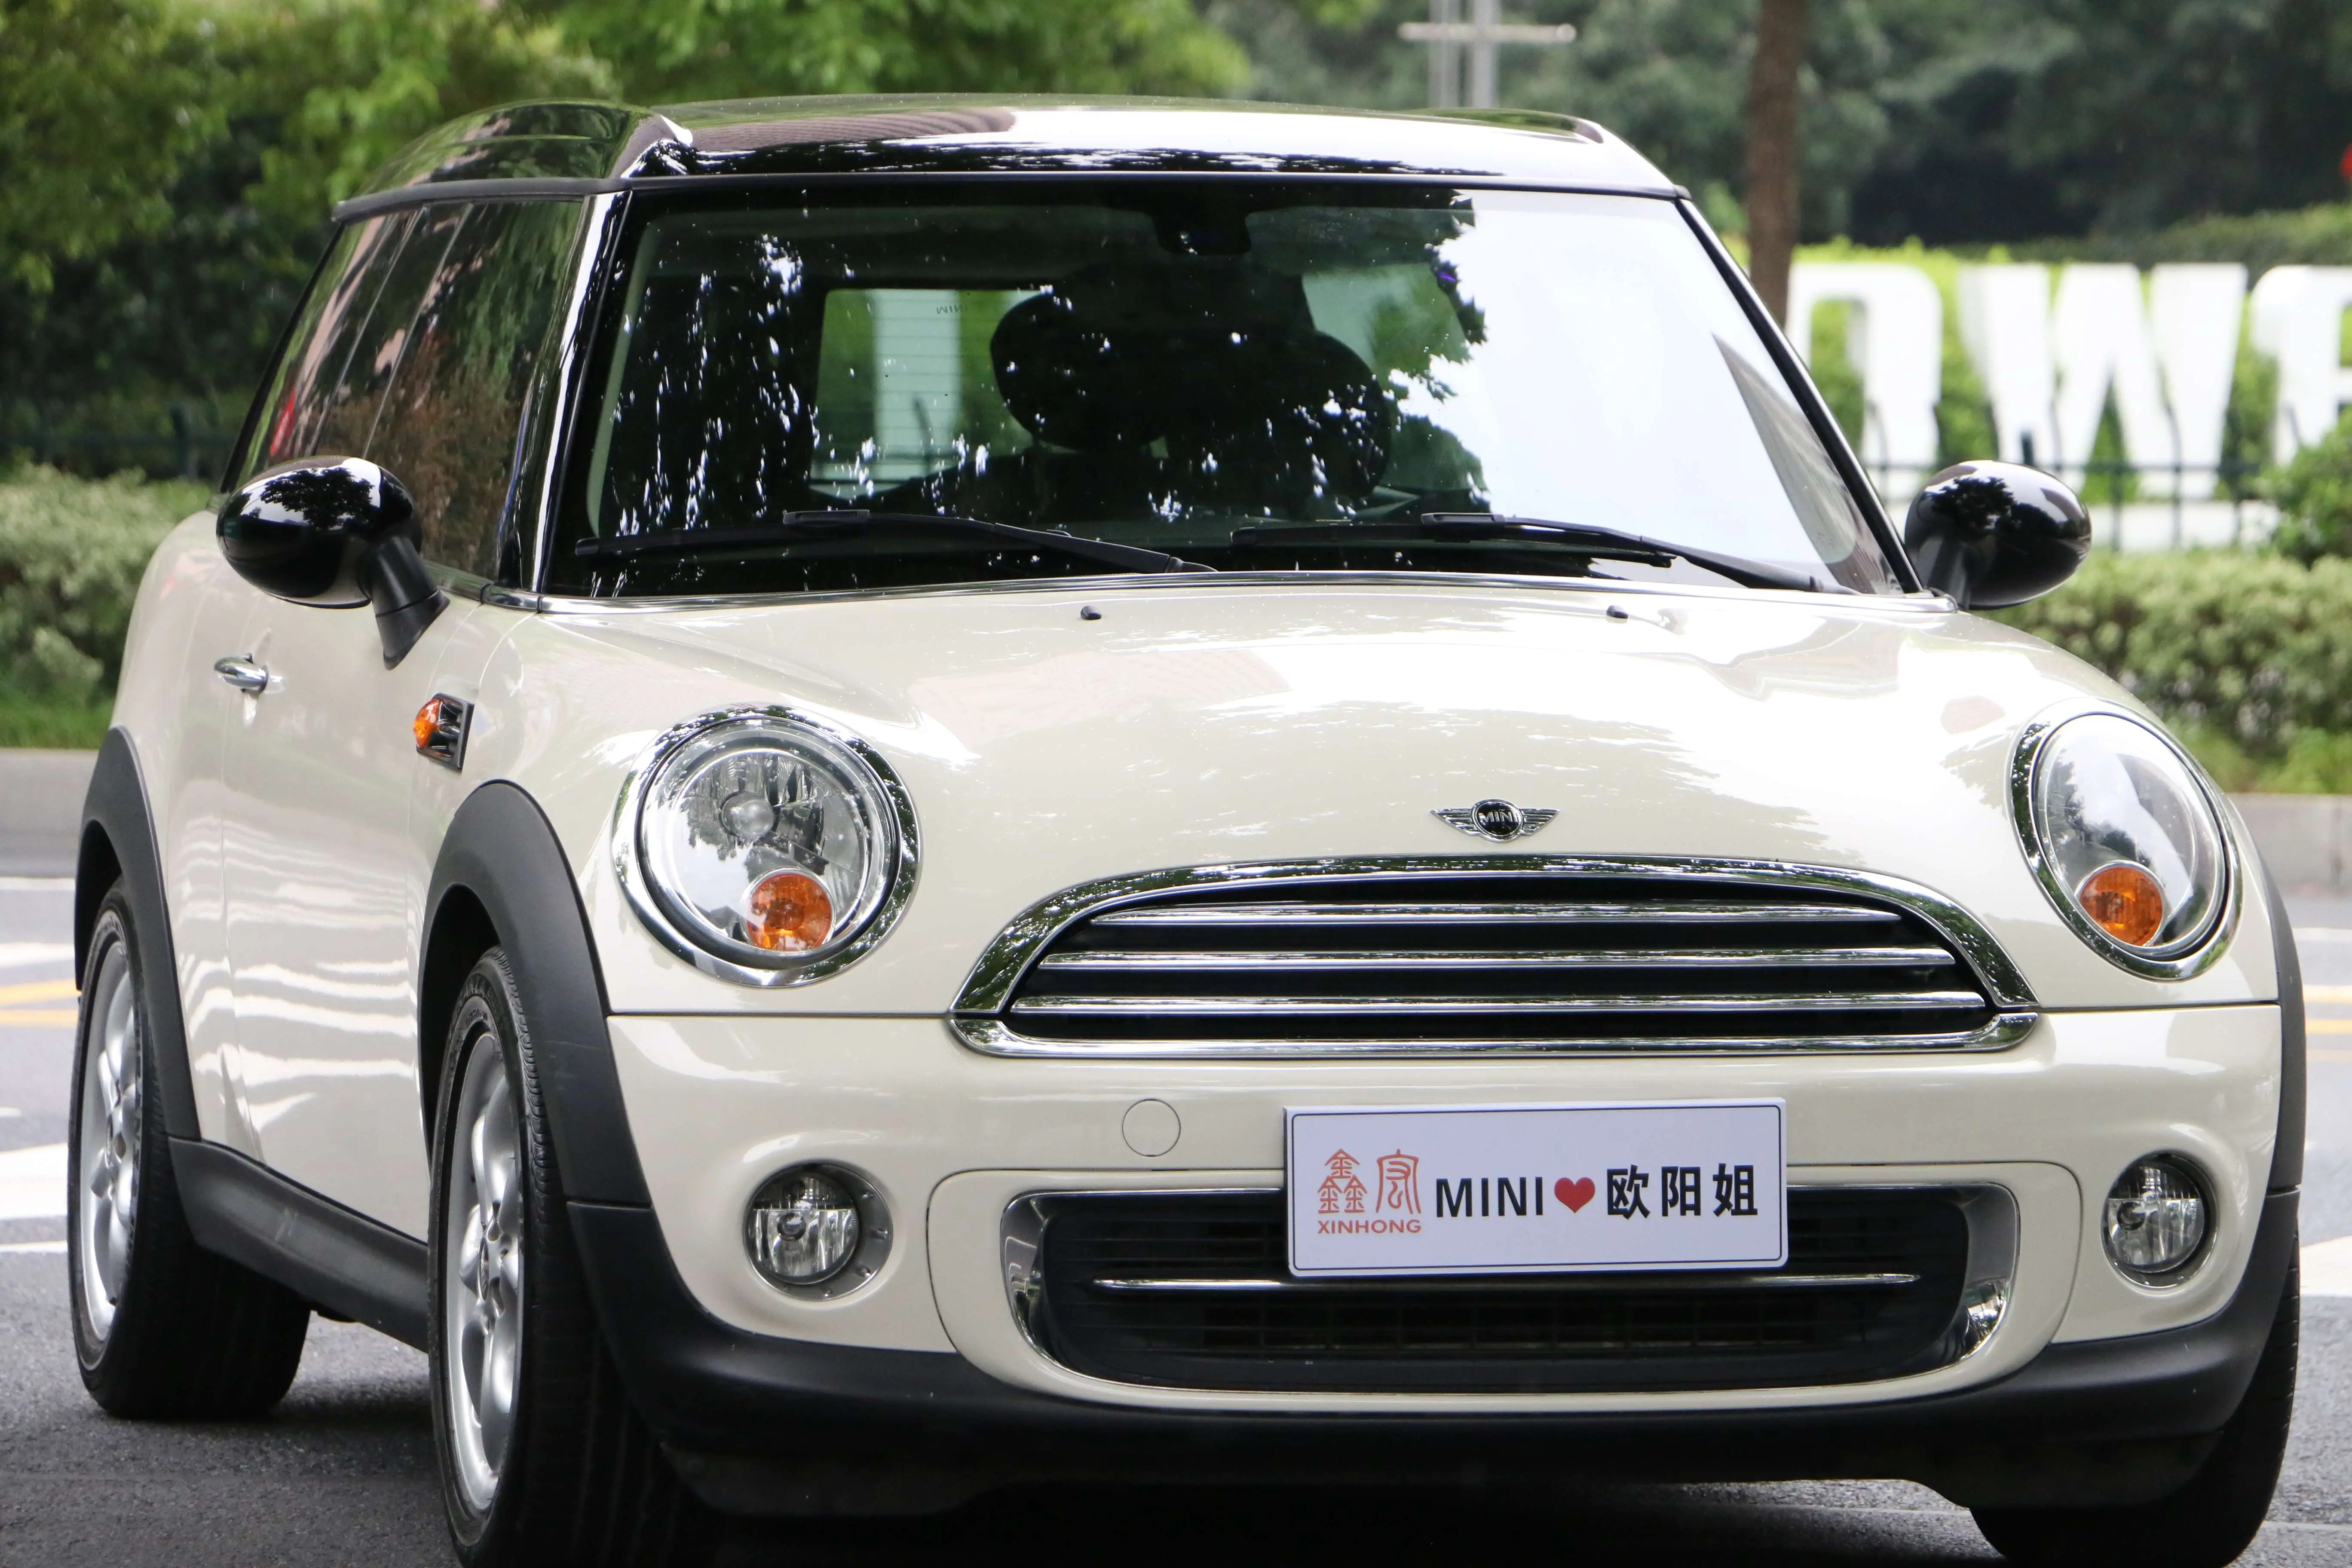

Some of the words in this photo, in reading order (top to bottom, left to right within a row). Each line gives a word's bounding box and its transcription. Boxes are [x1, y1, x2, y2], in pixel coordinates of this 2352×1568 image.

[1478, 811, 1519, 824] MINI
[1436, 1176, 1543, 1218] MINI
[1607, 1163, 1758, 1220] 欧阳姐
[1317, 1219, 1422, 1234] XINHONG
